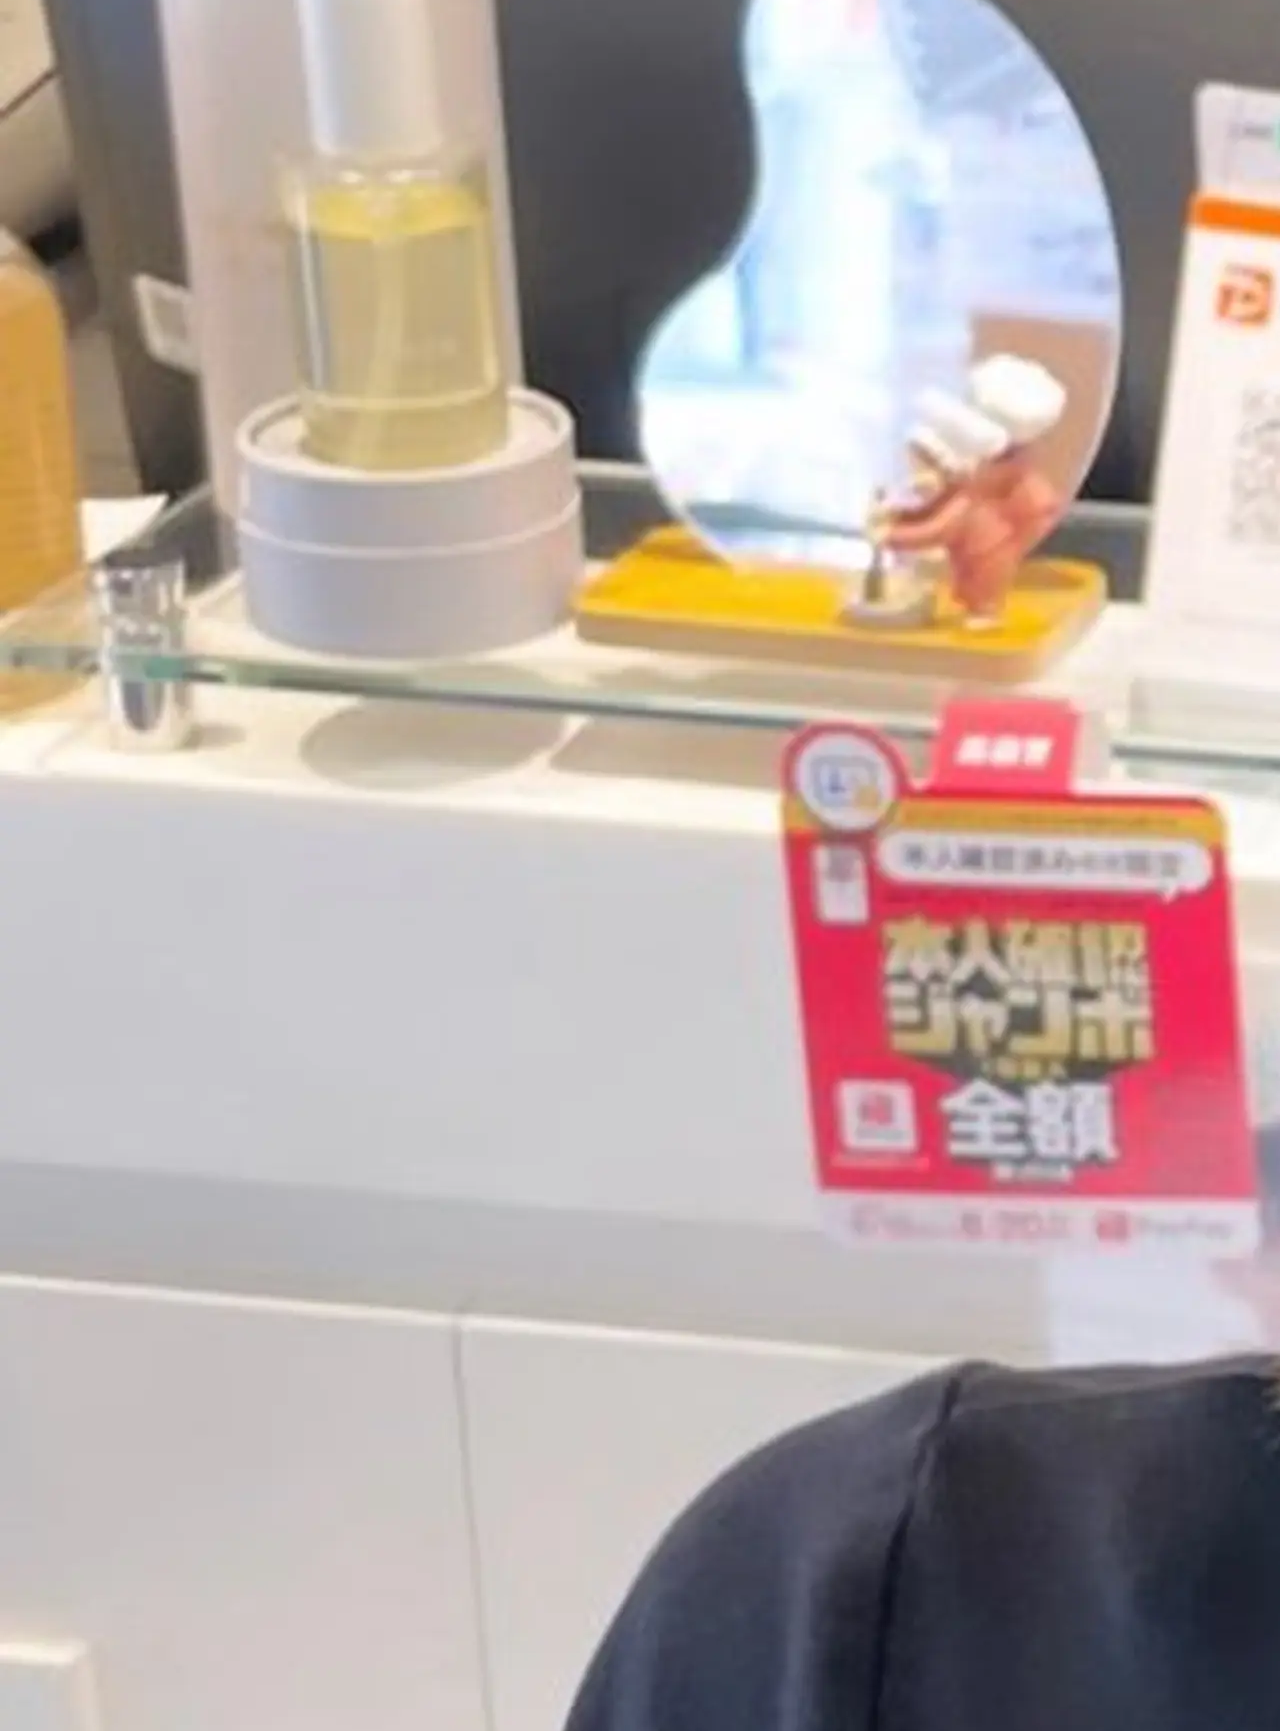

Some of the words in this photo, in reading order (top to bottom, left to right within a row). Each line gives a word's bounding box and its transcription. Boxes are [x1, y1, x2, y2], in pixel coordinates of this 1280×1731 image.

[884, 979, 1156, 1061] ジャンボ
[939, 1078, 1121, 1163] 全額
